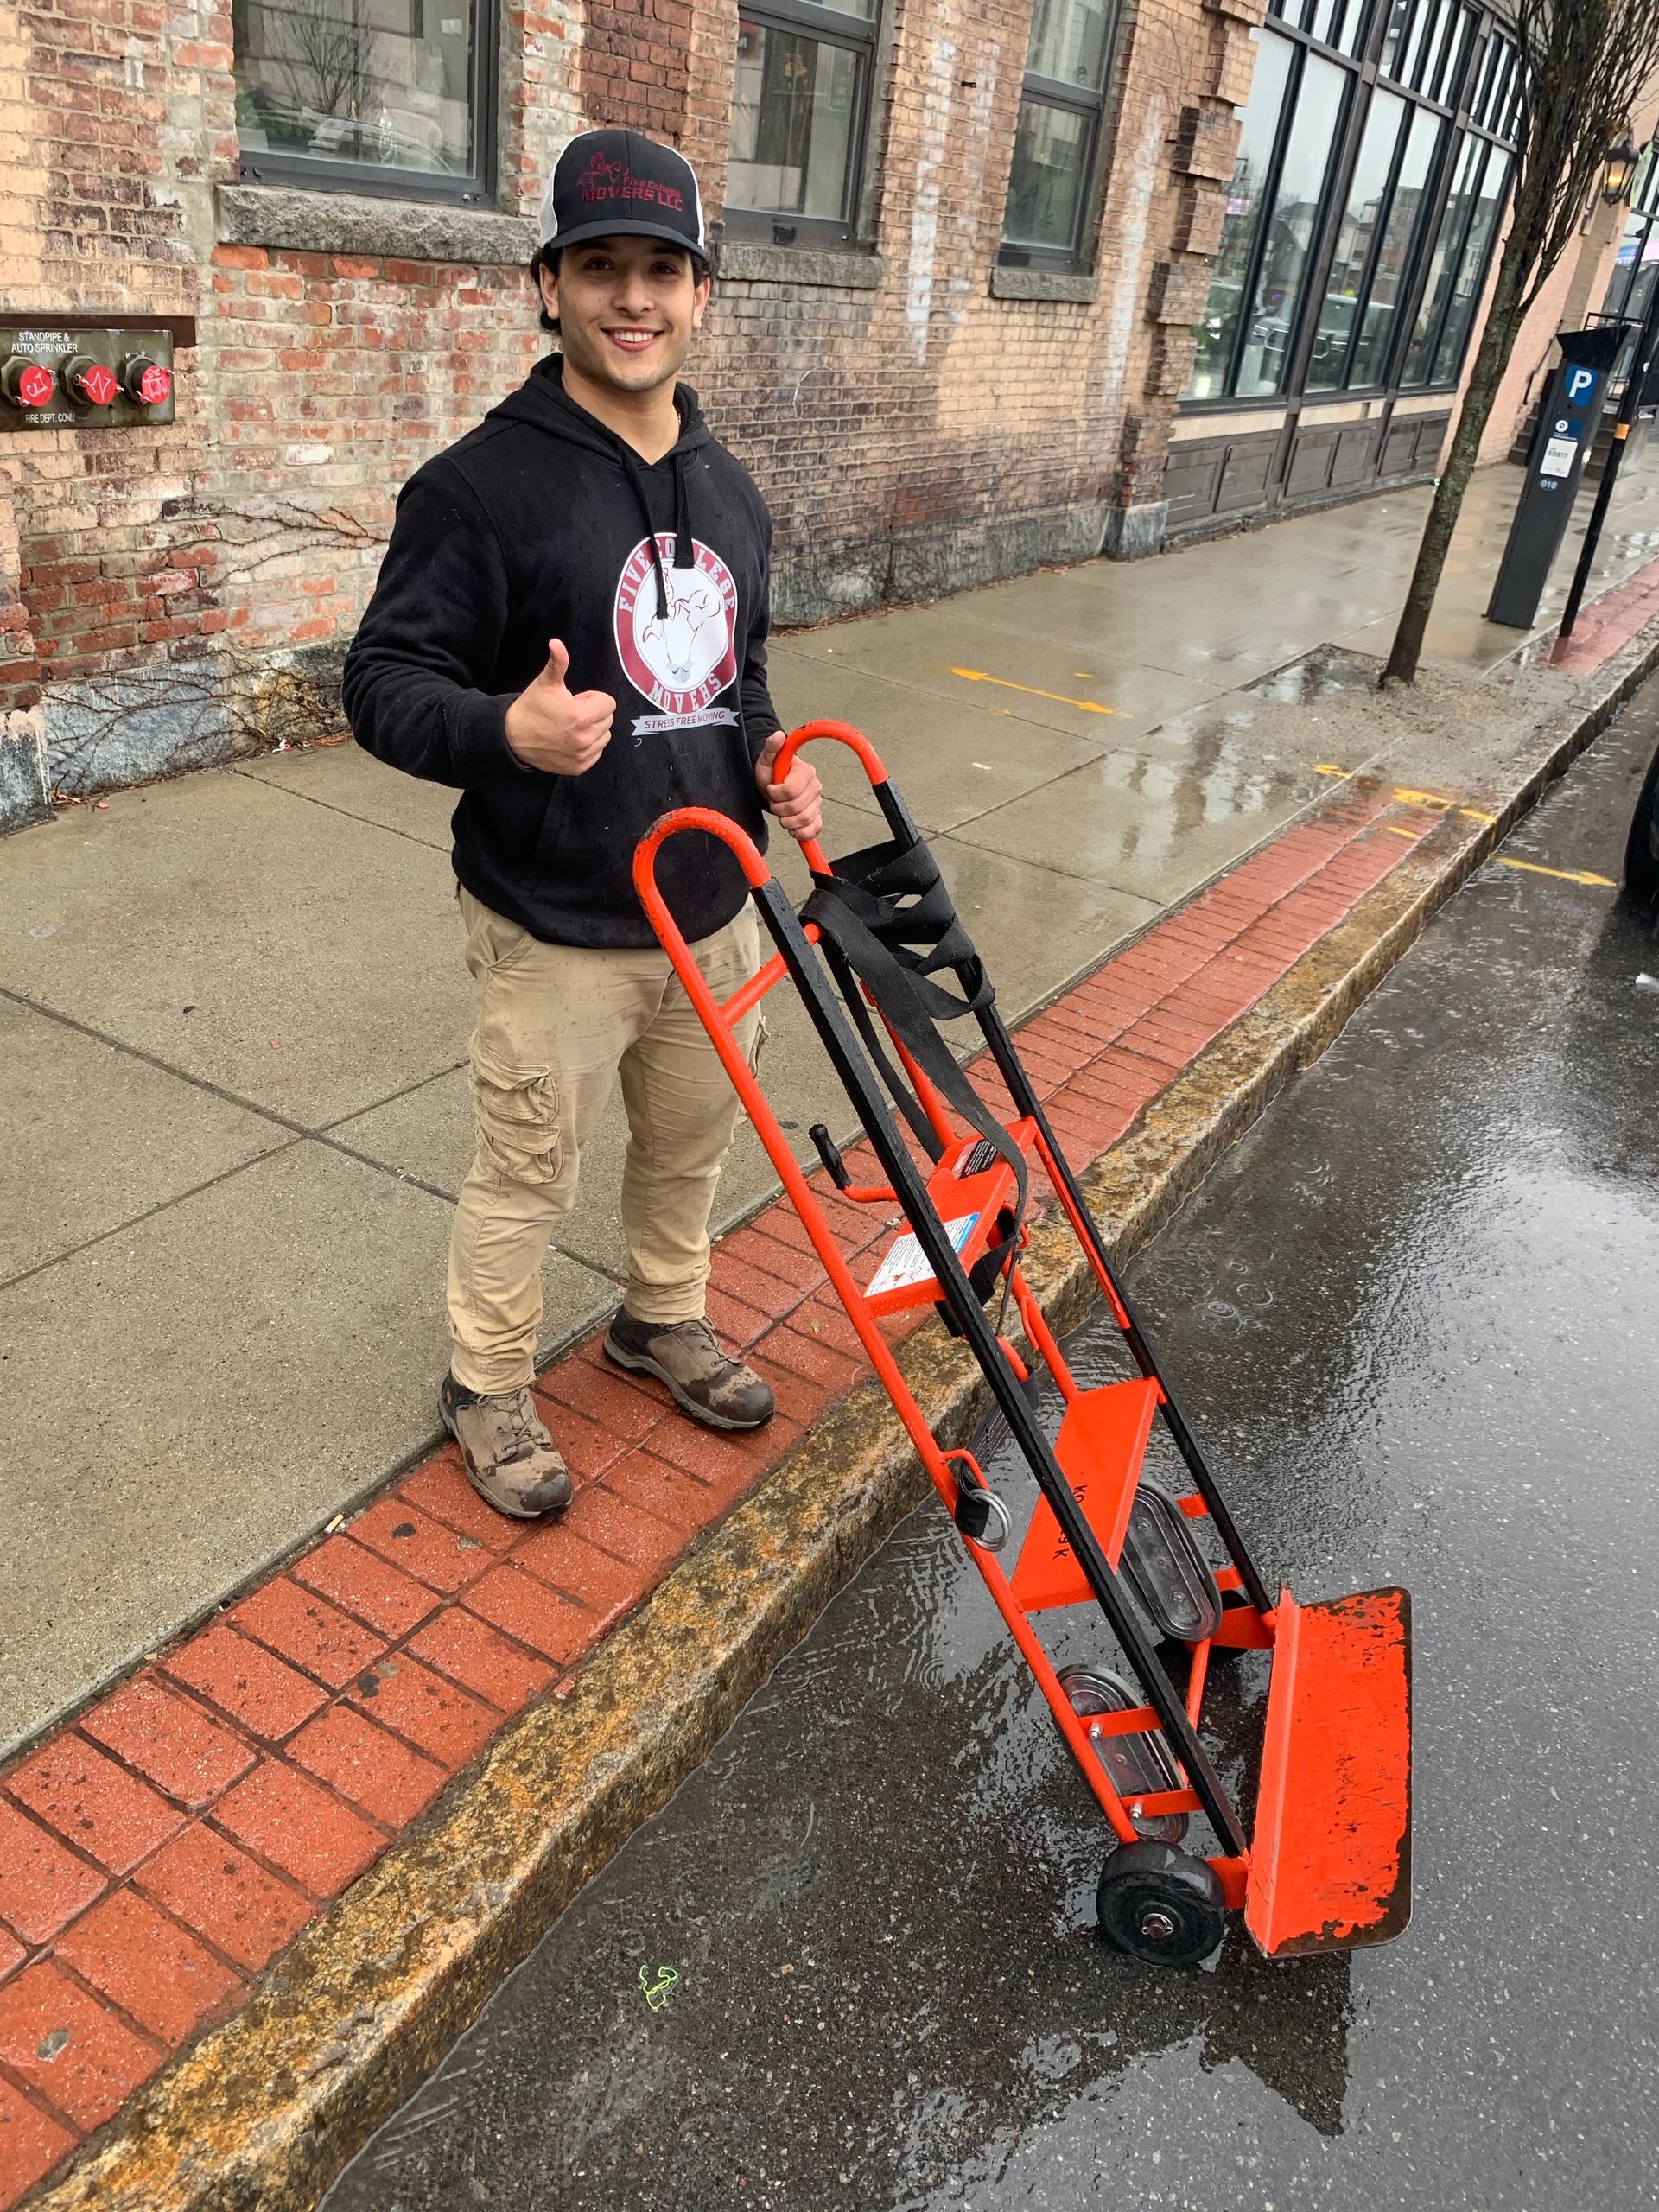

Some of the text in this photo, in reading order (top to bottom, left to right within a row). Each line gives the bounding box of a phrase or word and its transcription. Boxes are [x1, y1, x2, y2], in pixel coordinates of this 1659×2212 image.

[582, 186, 683, 212] MOVERS LLC
[11, 343, 79, 353] AUTO SPRINKLER
[18, 332, 70, 342] STANDPIPE &
[1568, 370, 1592, 398] P
[25, 414, 40, 423] FIRE
[618, 537, 734, 614] FIVE OLEGE
[648, 673, 722, 714] MOVERS
[645, 711, 726, 729] STRESS FREE MOVING
